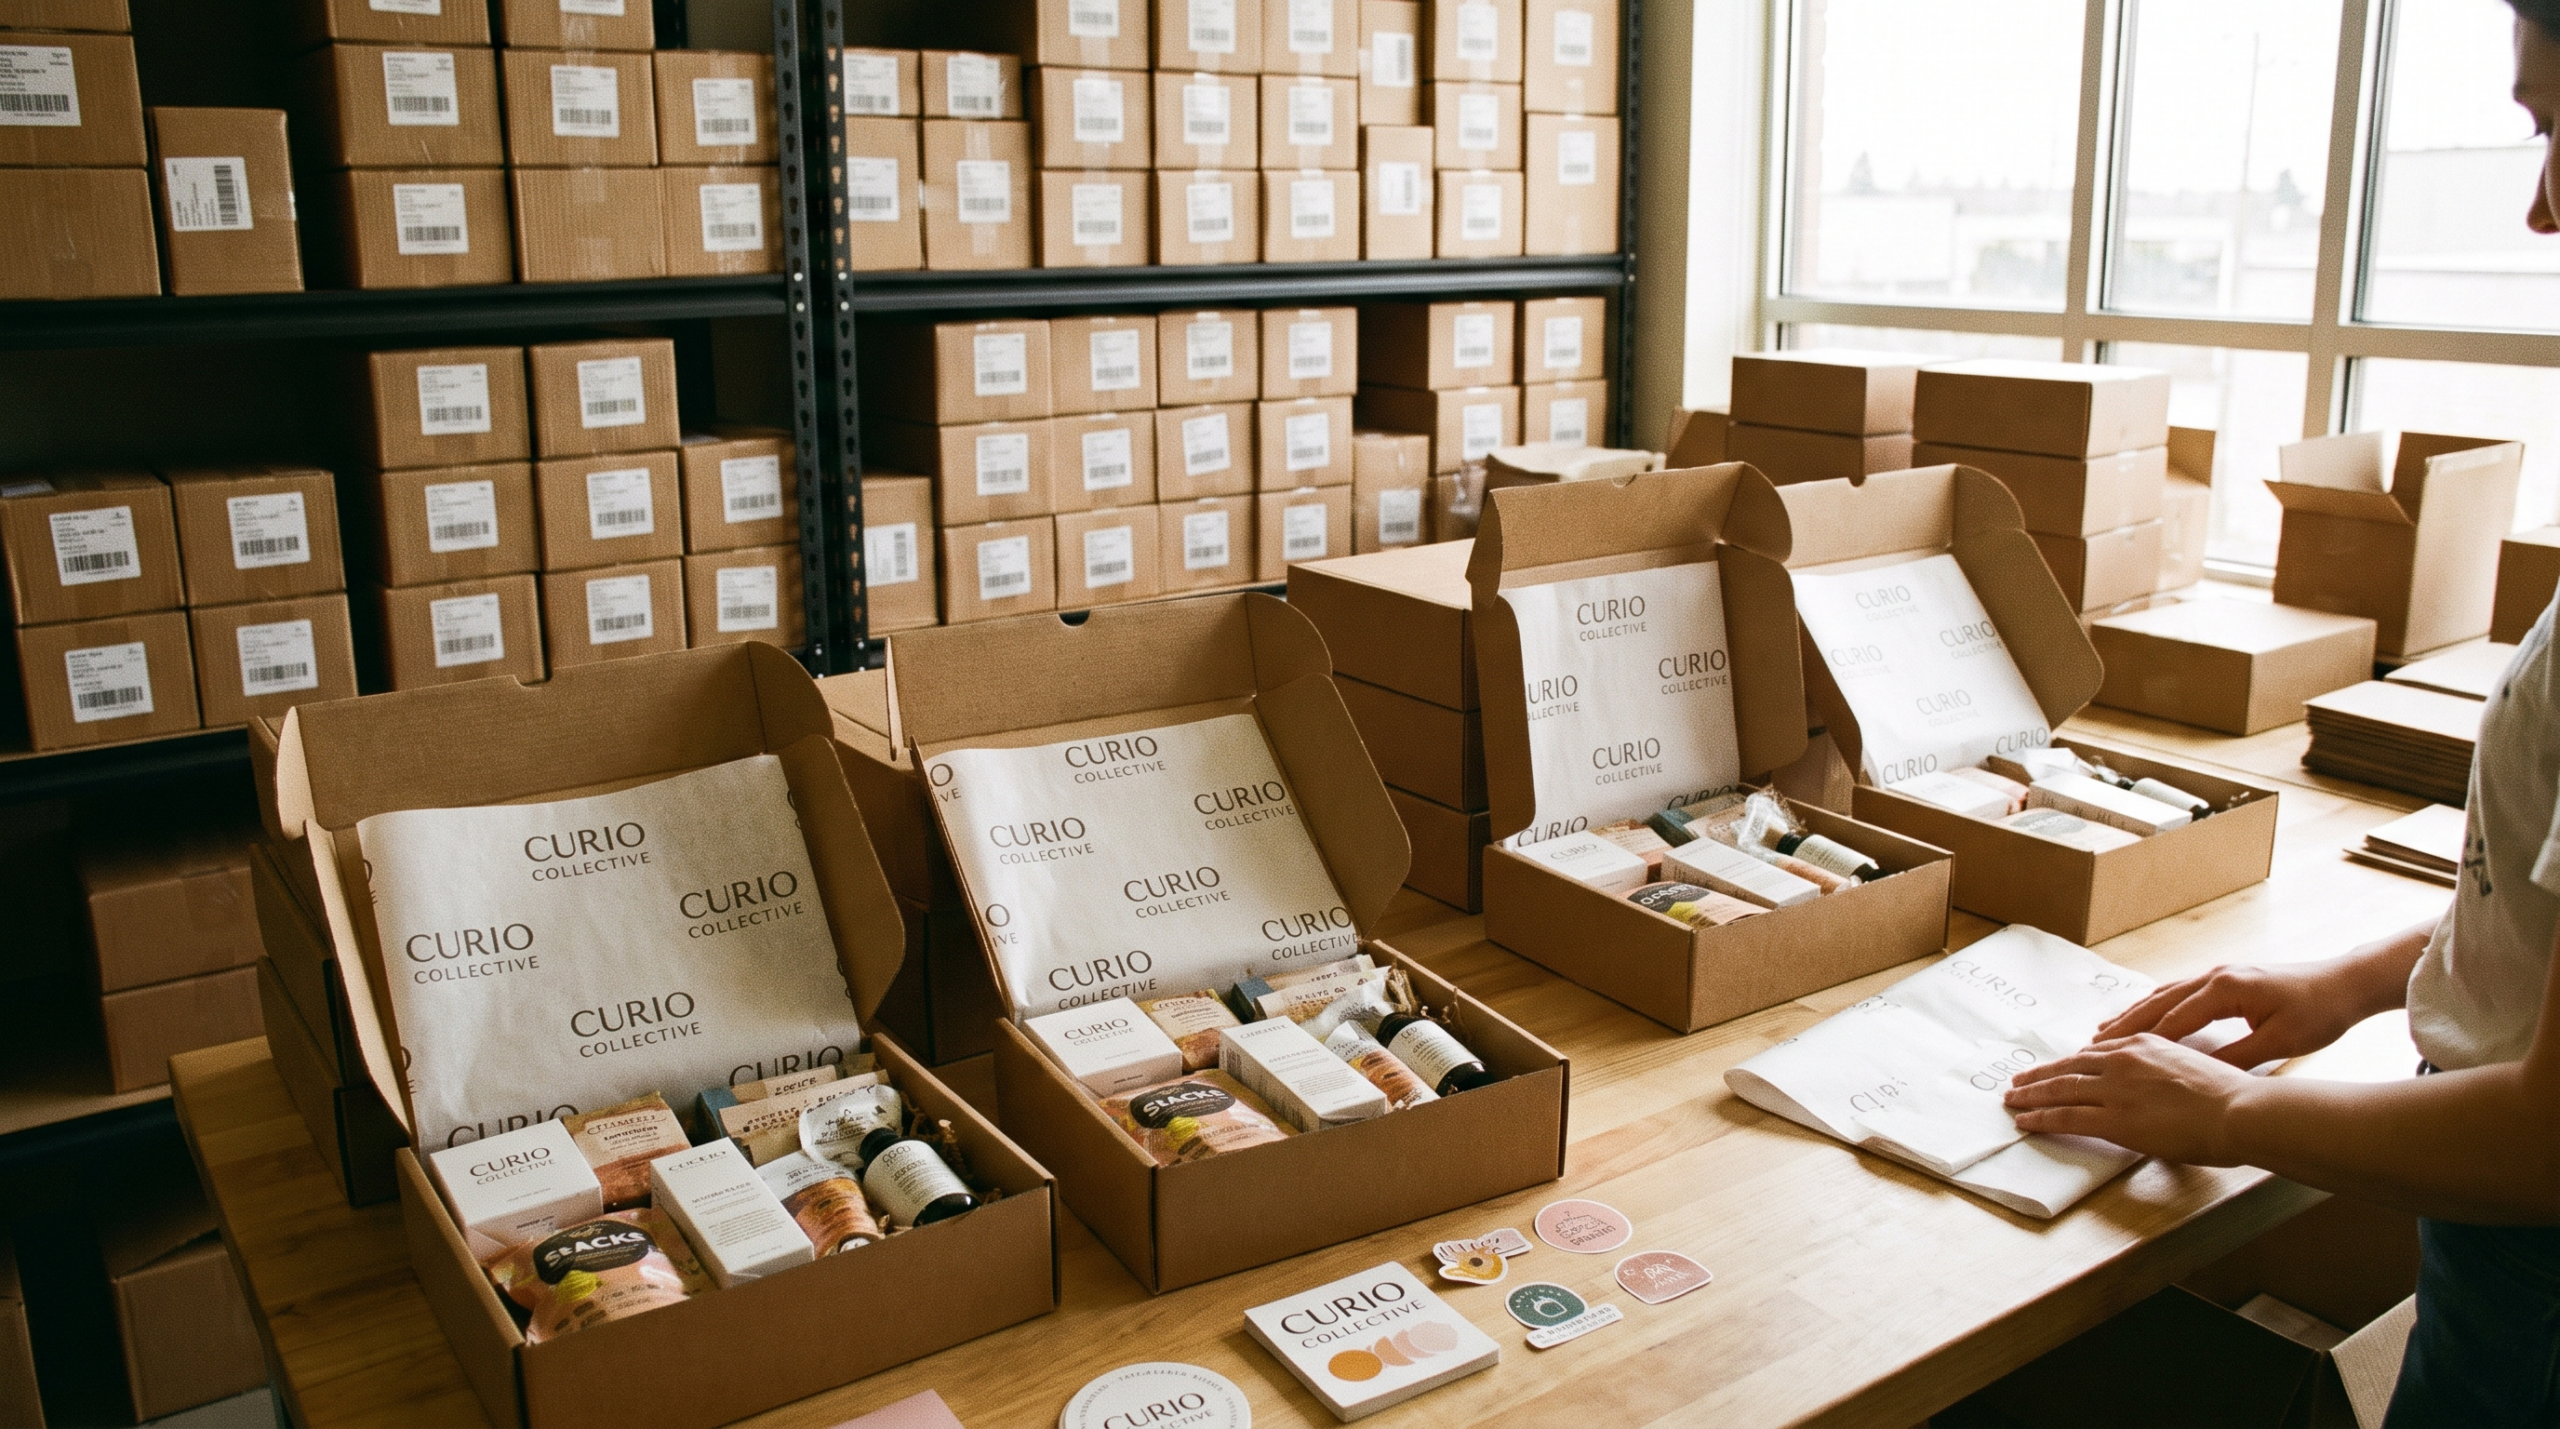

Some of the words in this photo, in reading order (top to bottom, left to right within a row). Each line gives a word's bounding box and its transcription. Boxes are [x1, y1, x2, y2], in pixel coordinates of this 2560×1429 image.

[1577, 595, 1645, 625] CURIO
[1855, 585, 1911, 609] CURIO
[1580, 622, 1647, 641] COLLECTIVE
[1940, 621, 1996, 647] CURIO
[1659, 649, 1726, 679] CURIO
[1831, 644, 1883, 667] CURIO
[1528, 675, 1577, 704] URIO
[1661, 674, 1727, 695] COLLECTIVE
[1527, 702, 1579, 721] OLLECTIVE
[1916, 689, 1971, 715] CURIO
[1064, 736, 1158, 768] CURIO
[1592, 737, 1661, 769] CURIO
[1996, 727, 2048, 755] CURIO
[1074, 760, 1166, 784] COLLECTIVE
[1595, 763, 1663, 785] COLLECTIVE
[1883, 754, 1938, 784] CURIO
[1193, 780, 1286, 816] CURIO
[1205, 804, 1295, 831] COLLECTIVE
[524, 822, 646, 863] CURIO
[989, 817, 1086, 849] CURIO
[532, 851, 651, 881] COLLECTIVE
[1000, 843, 1094, 865] COLLECTIVE
[680, 871, 799, 920] CURIO
[1123, 866, 1221, 903] CURIO
[1135, 890, 1230, 919] COLLECTIVE
[688, 901, 804, 939] COLLECTIVE
[1262, 907, 1351, 941] CURIO
[405, 923, 534, 963] CURIO
[414, 955, 540, 985] COLLECTIVE
[1049, 950, 1152, 992] CURIO
[1952, 960, 2037, 1008] CURIO
[1058, 978, 1157, 1010] COLLECTIVE
[570, 991, 695, 1038] CURIO
[1064, 1019, 1128, 1039] CURIO
[579, 1021, 702, 1058] COLLECTIVE
[1970, 1048, 2036, 1091] CURIO
[470, 1147, 550, 1177] CURIO
[476, 1158, 556, 1185] COLLECTIVE
[1281, 1282, 1405, 1335] CURIO
[1302, 1299, 1426, 1349] COLLECTIVE
[1104, 1393, 1205, 1429] CURIO
